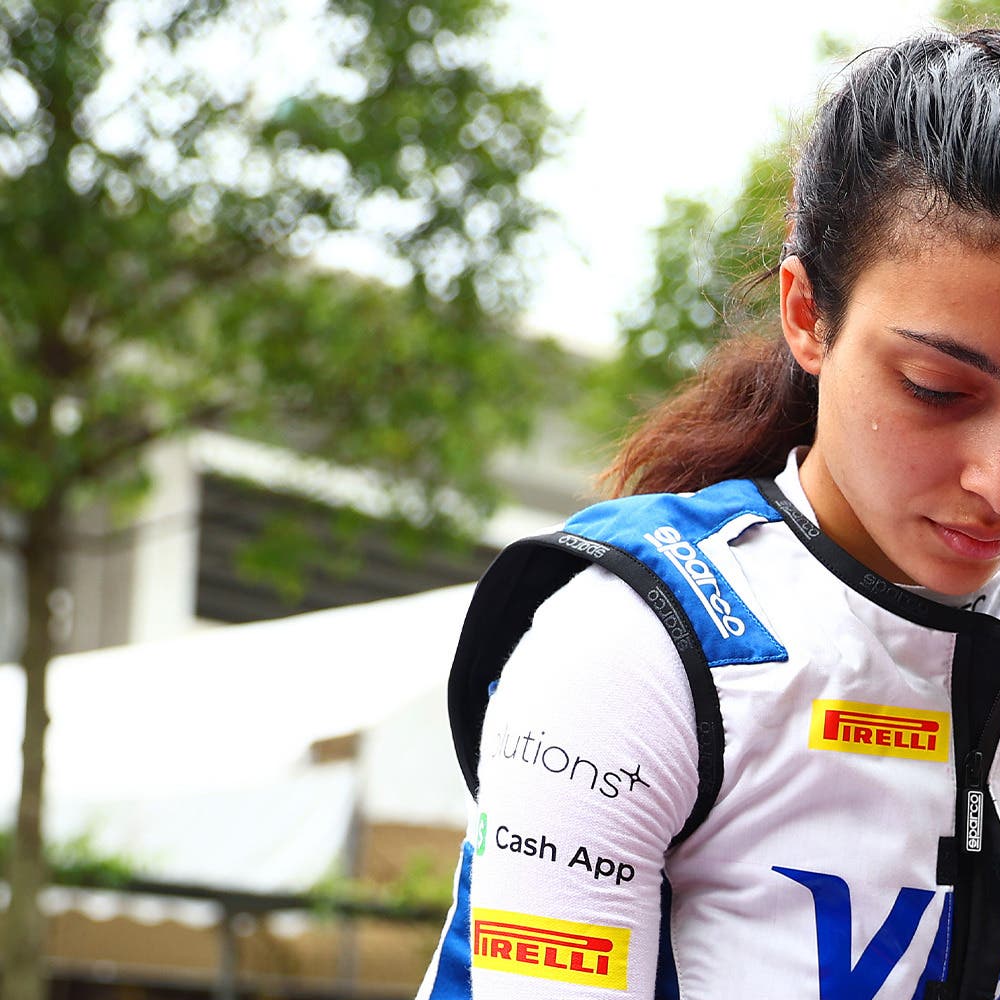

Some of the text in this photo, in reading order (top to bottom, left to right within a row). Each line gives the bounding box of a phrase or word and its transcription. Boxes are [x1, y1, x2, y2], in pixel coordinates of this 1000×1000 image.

[558, 534, 610, 559] sparco
[643, 526, 746, 639] sparco
[823, 709, 940, 751] PIRELLI
[493, 722, 622, 799] lutions
[969, 793, 981, 849] sparco
[496, 825, 635, 885] Cash App
[474, 920, 613, 976] PIRELLI
